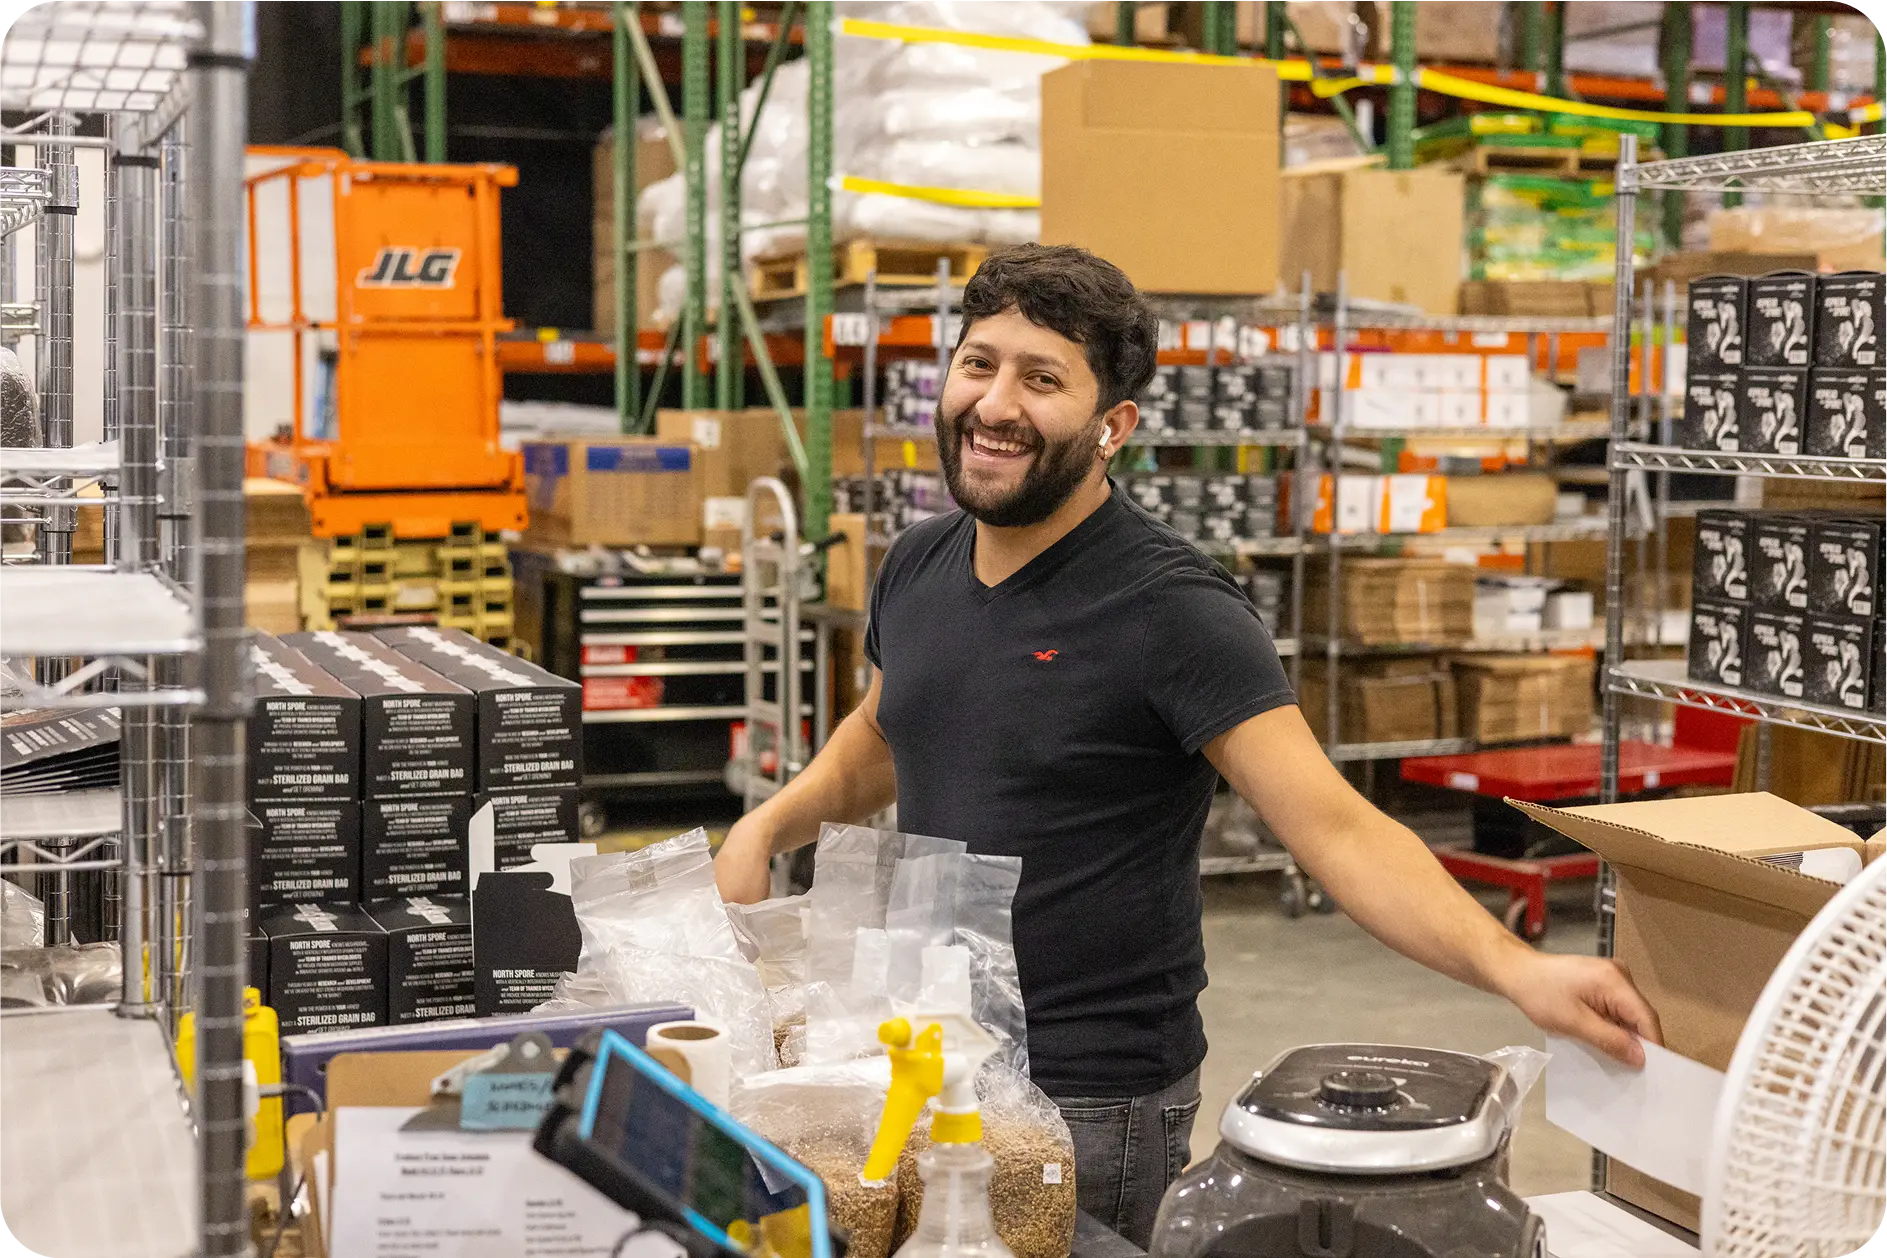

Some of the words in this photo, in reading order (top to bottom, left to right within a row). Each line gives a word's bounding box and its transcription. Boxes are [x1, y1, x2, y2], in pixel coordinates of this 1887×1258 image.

[359, 249, 456, 285] JLG
[496, 694, 514, 702] NORTH
[515, 693, 532, 701] SPORE
[383, 700, 402, 708] NORTH
[403, 699, 421, 708] SPORE
[504, 762, 540, 773] STERILIZED
[541, 761, 560, 771] GRAIN
[561, 760, 574, 769] BAG
[273, 775, 311, 784] STERILIZED
[313, 775, 334, 783] GRAIN
[335, 774, 349, 783] BAG
[391, 770, 428, 780] STERILIZED
[429, 770, 449, 779] GRAIN
[450, 769, 464, 778] BAG
[491, 797, 510, 806] NORTH
[510, 796, 528, 804] SPORE
[266, 809, 286, 817] NORTH
[287, 808, 305, 816] SPORE
[380, 804, 399, 812] NORTH
[400, 803, 418, 812] SPORE
[389, 873, 425, 884] STERILIZED
[427, 872, 447, 881] GRAIN
[448, 871, 461, 880] BAG
[273, 880, 311, 890] STERILIZED
[313, 879, 333, 888] GRAIN
[335, 879, 348, 888] BAG
[407, 934, 427, 943] NORTH
[428, 932, 446, 942] SPORE
[290, 941, 310, 950] NORTH
[311, 940, 330, 949] SPORE
[492, 970, 514, 978] NORTH
[515, 970, 535, 978] SPORE
[415, 1006, 454, 1018] STERILIZED
[455, 1004, 475, 1014] GRAIN
[297, 1015, 337, 1026] STERILIZED
[338, 1013, 360, 1024] GRAIN
[361, 1012, 375, 1022] BAG
